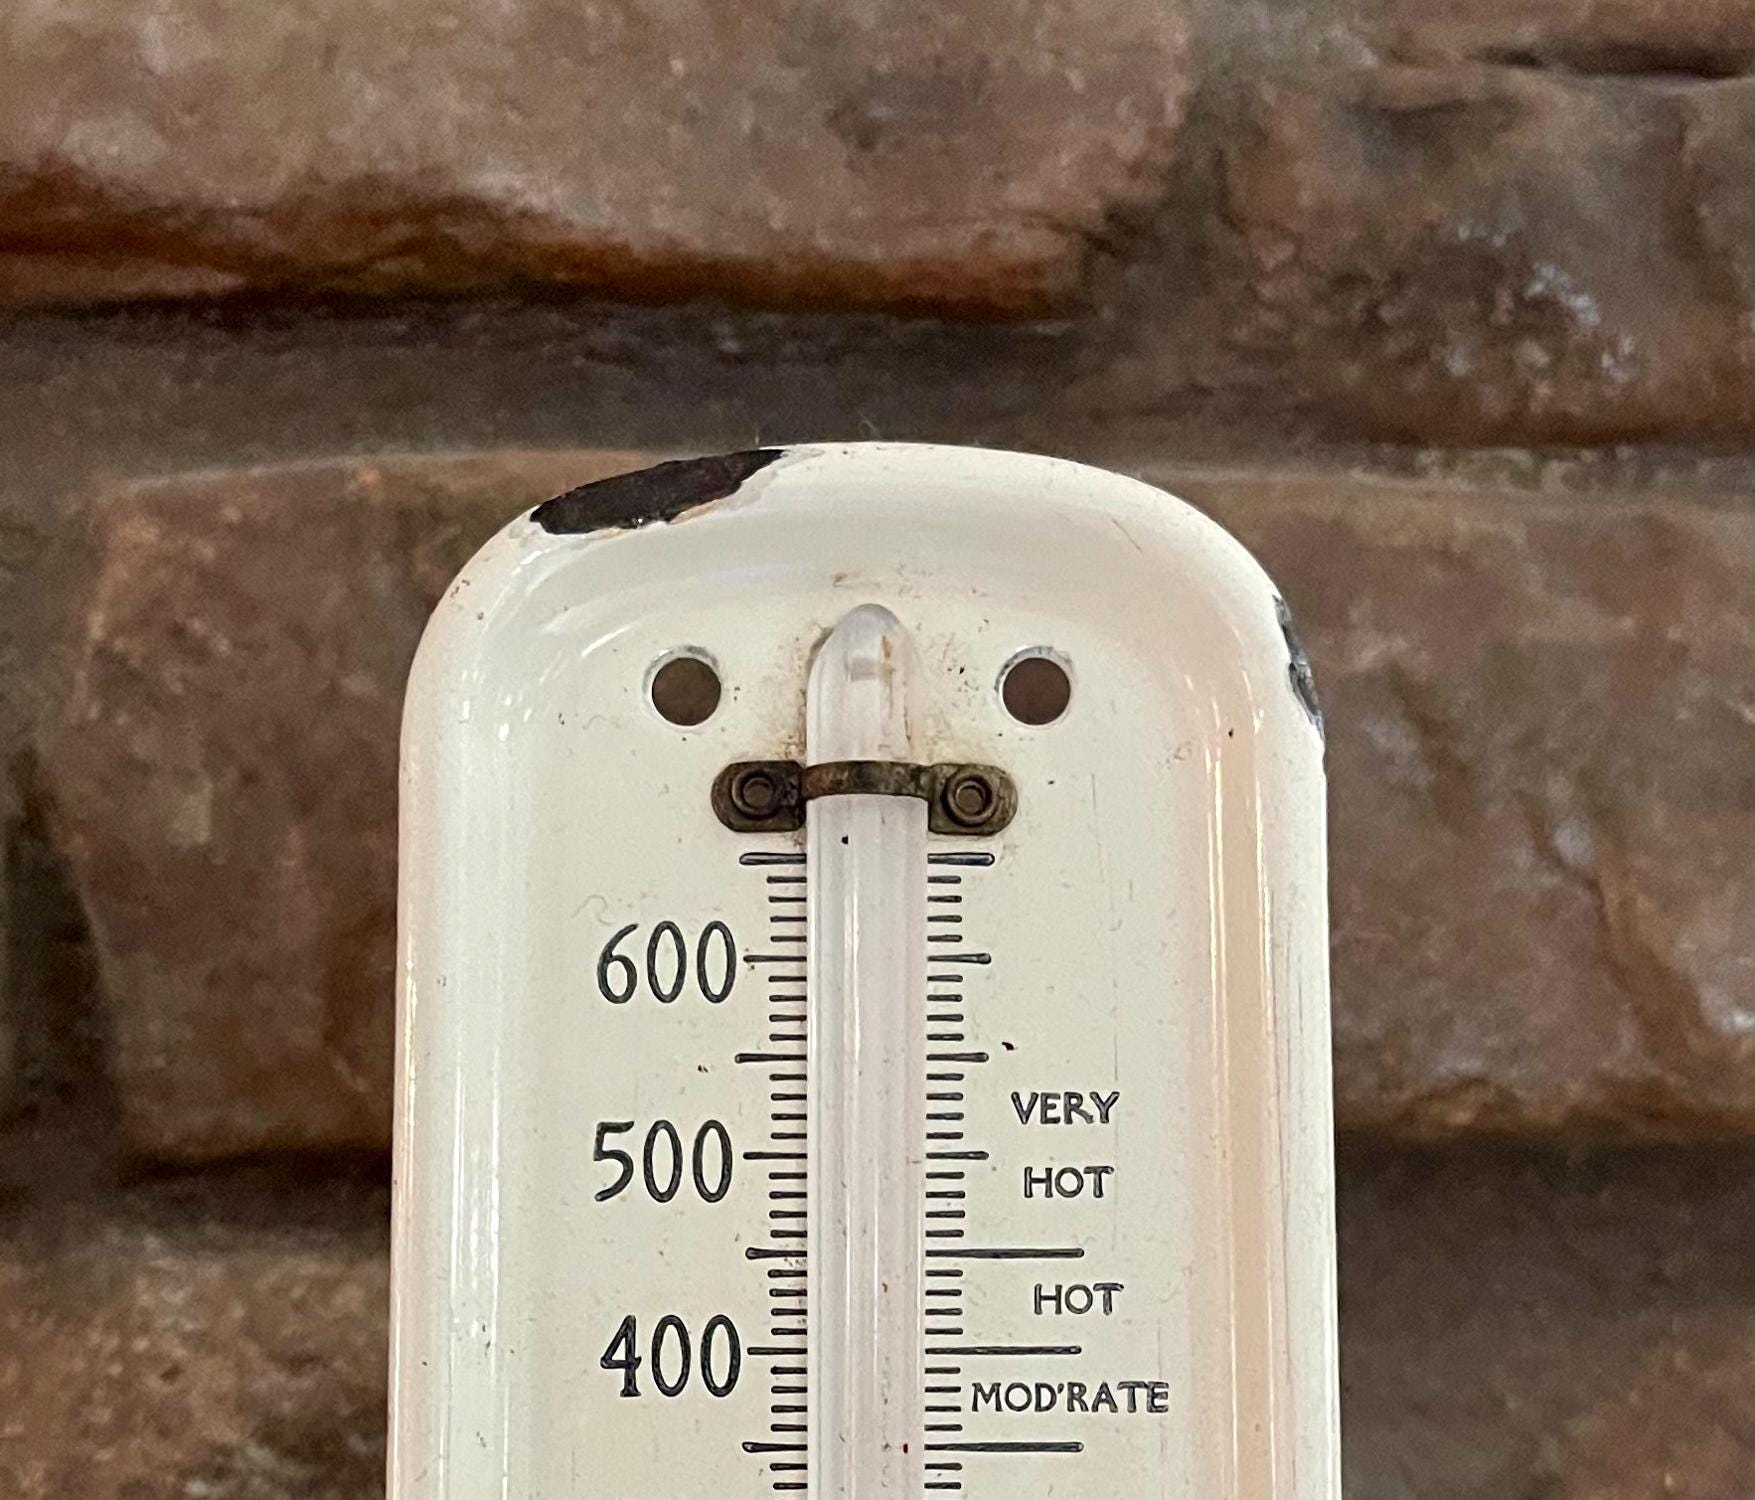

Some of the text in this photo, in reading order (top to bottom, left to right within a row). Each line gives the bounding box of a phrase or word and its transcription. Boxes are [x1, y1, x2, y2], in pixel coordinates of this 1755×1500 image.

[596, 920, 737, 1005] 600
[1010, 1091, 1121, 1126] VERY
[592, 1119, 734, 1204] 500
[1023, 1165, 1115, 1199] HOT
[1033, 1282, 1125, 1317] HOT
[599, 1313, 742, 1398] 400
[970, 1380, 1170, 1414] MOD'RATE
